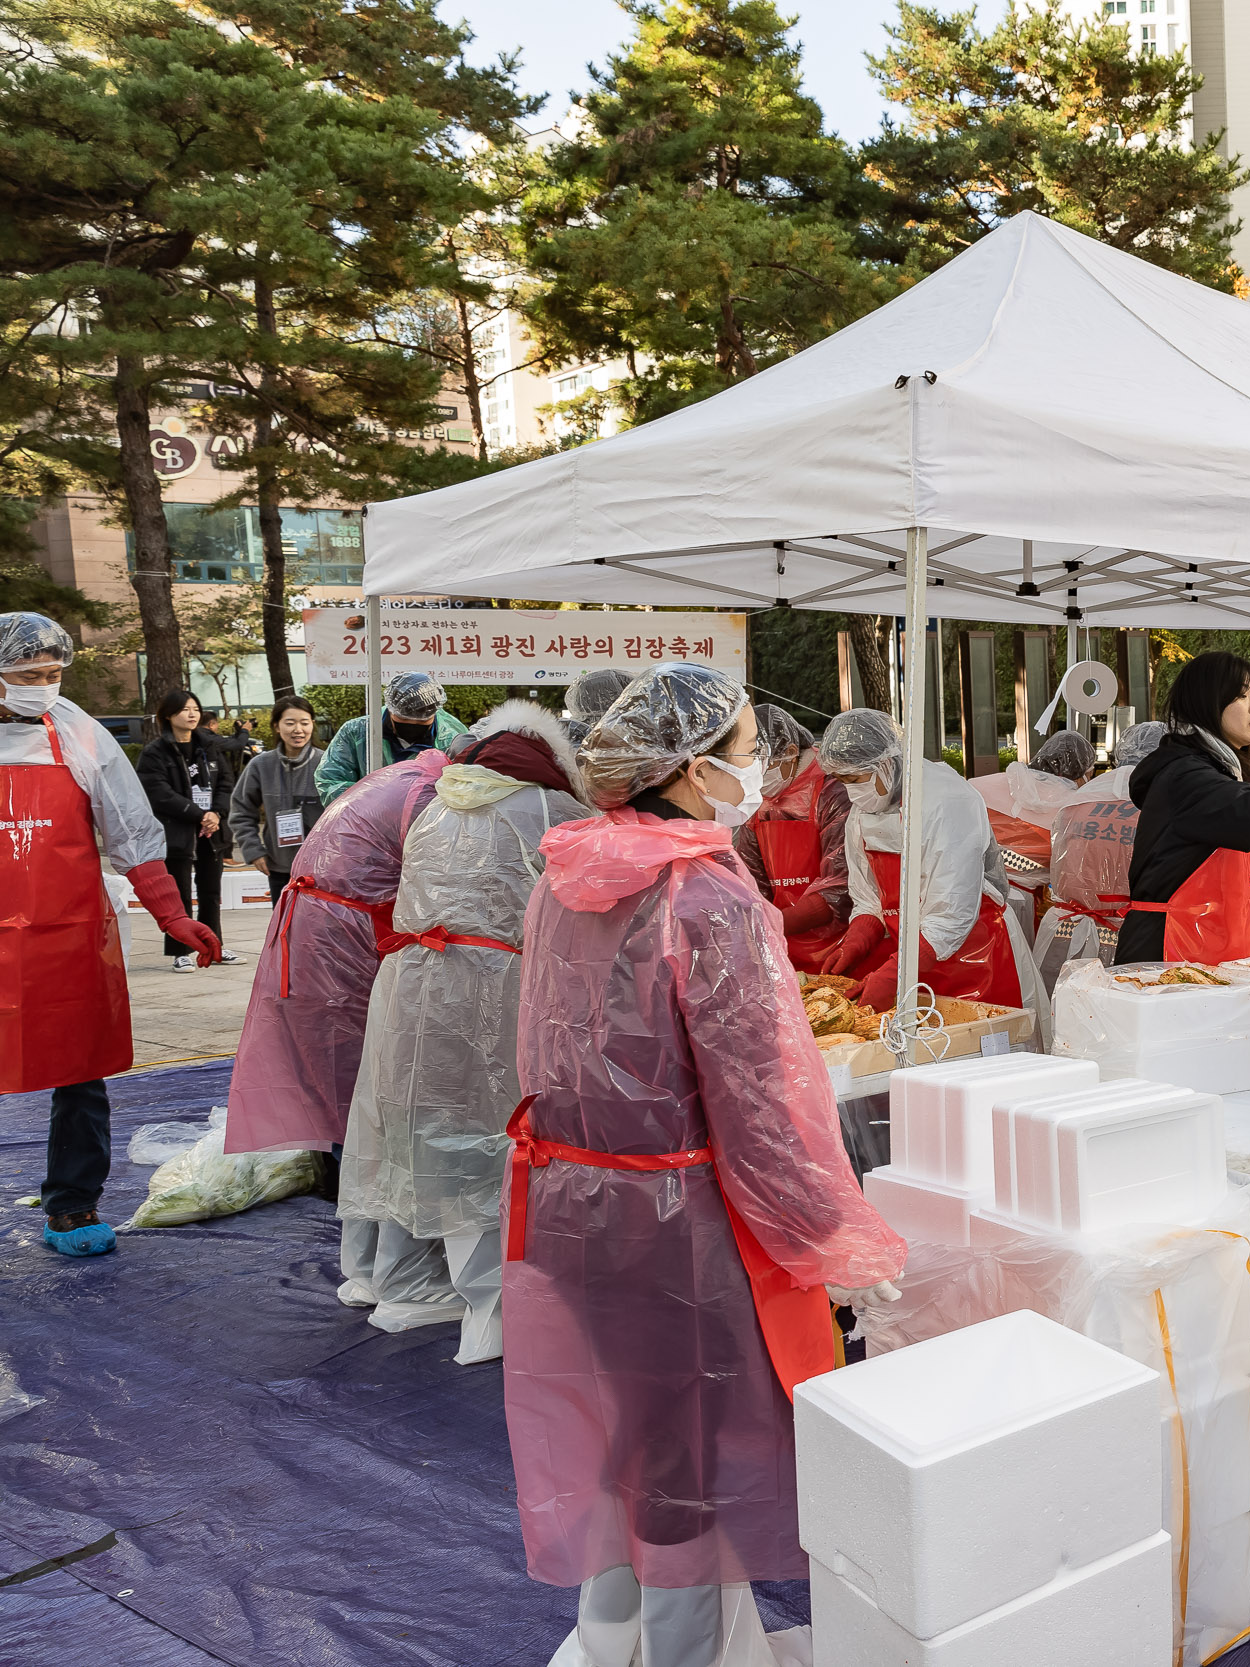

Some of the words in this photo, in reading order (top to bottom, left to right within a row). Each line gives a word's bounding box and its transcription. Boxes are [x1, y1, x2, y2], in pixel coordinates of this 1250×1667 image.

[393, 620, 429, 629] 한상자로
[431, 620, 458, 629] 전하는
[460, 620, 478, 629] 안부
[420, 634, 481, 658] 제1회
[490, 634, 536, 658] 광진
[545, 635, 613, 659] 사랑의
[623, 635, 714, 660] 김장축제
[451, 670, 497, 679] 나루아트센터
[782, 876, 810, 887] 김장축제
